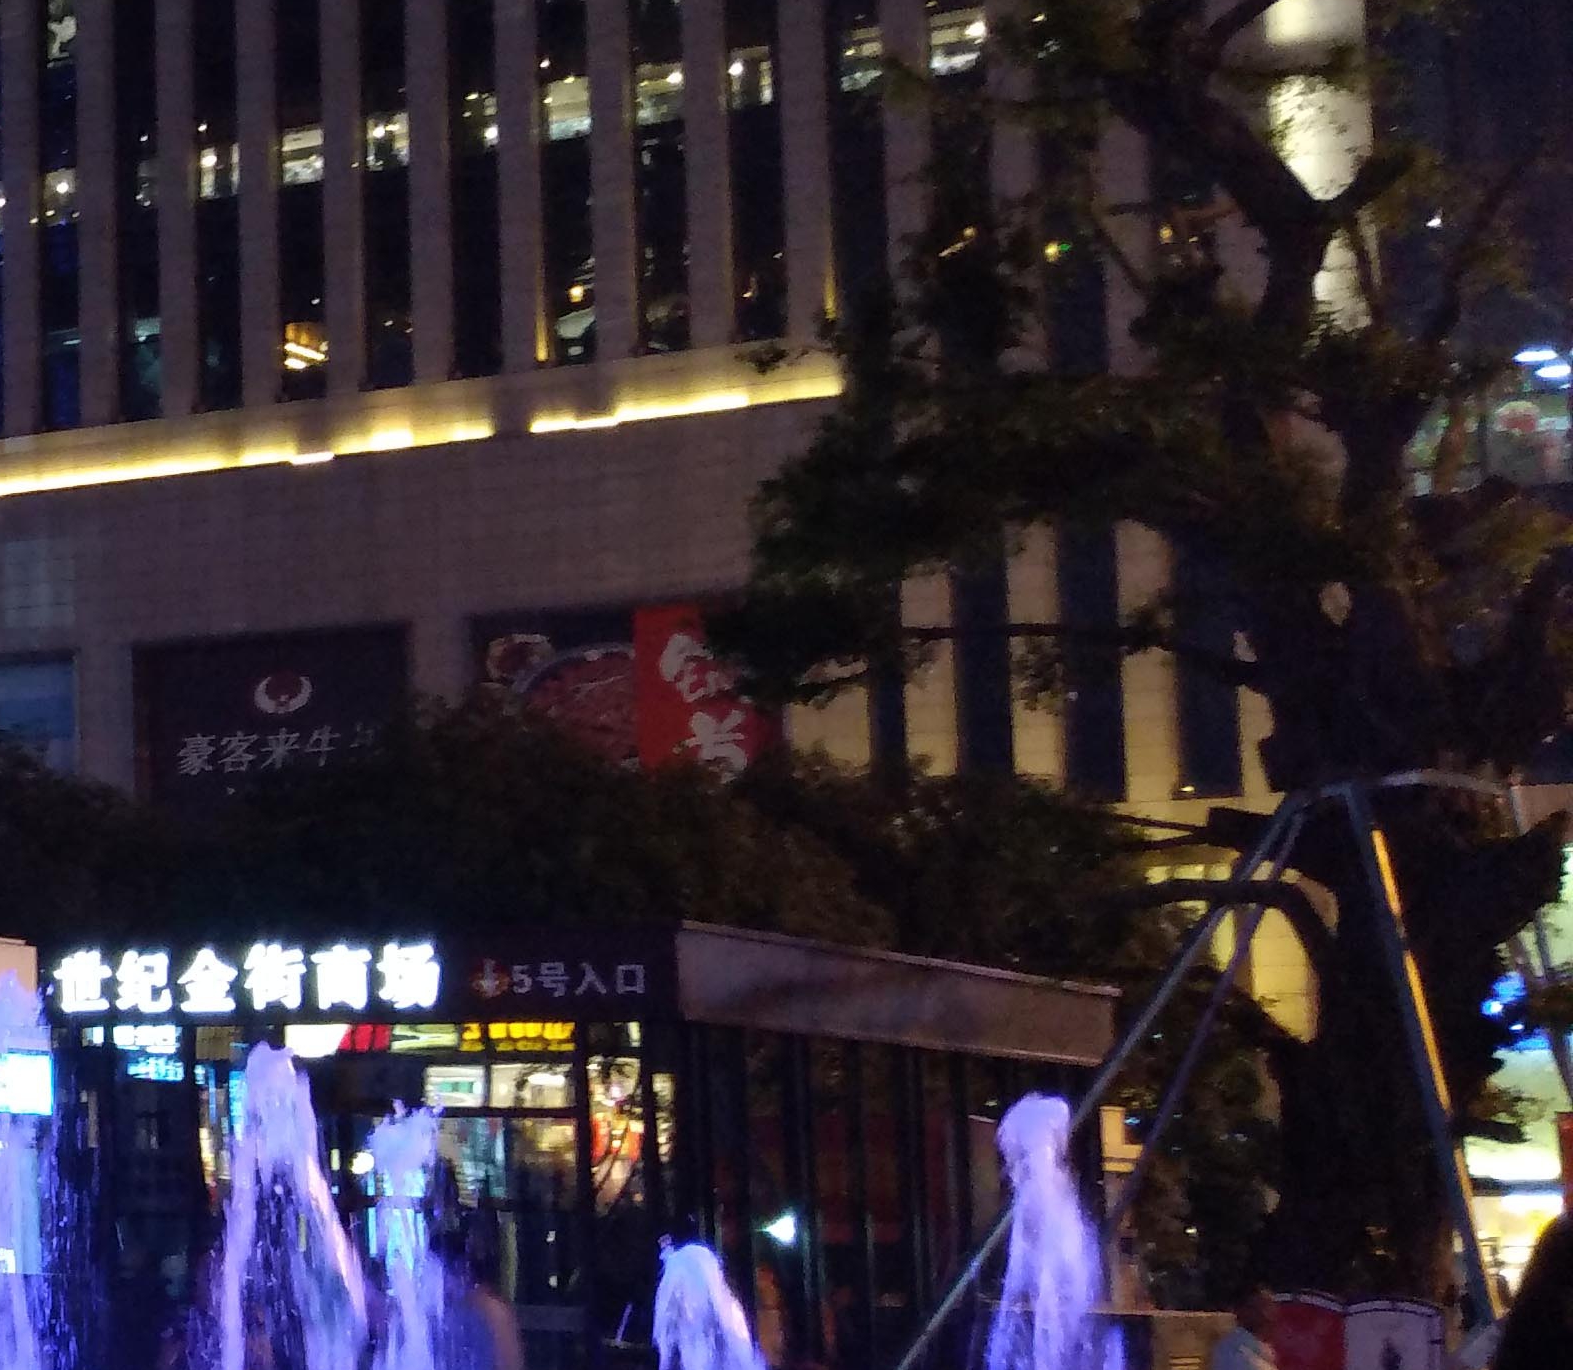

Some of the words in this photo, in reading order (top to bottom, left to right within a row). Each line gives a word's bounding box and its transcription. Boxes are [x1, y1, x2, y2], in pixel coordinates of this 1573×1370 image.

[53, 942, 442, 1013] 世纪金街商场
[511, 961, 646, 998] 5号入口
